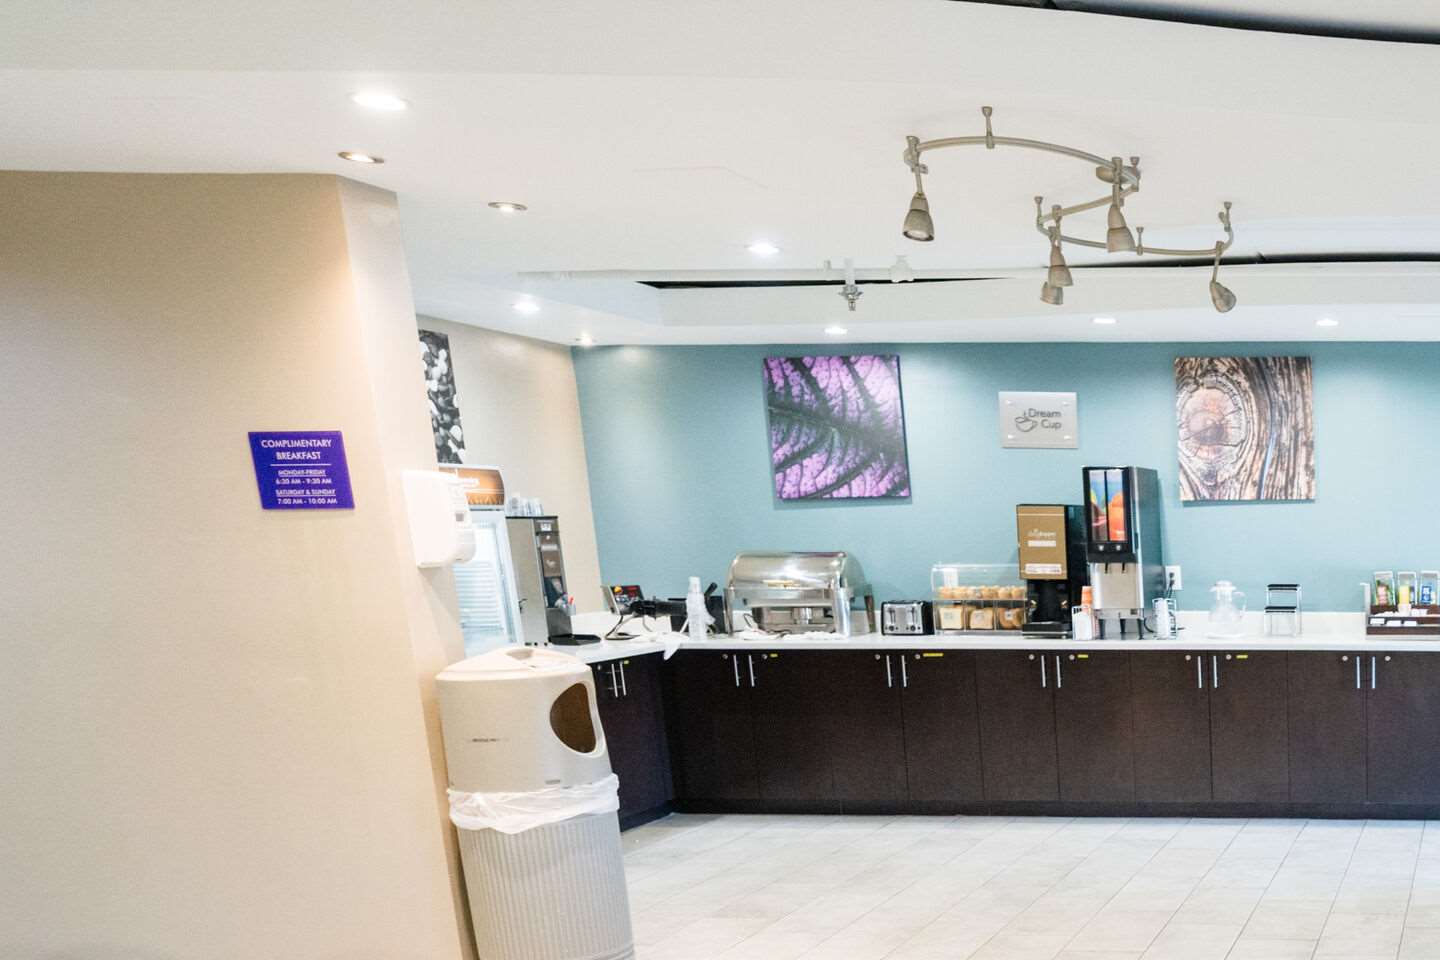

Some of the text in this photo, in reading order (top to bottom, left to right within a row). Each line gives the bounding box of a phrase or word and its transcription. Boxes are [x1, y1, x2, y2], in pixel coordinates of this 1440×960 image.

[1028, 408, 1062, 418] Dream
[1040, 419, 1062, 430] Cup
[261, 439, 332, 448] COMPLIMENTARY
[276, 451, 322, 460] BREAKFAST
[275, 489, 305, 497] SATURDAY
